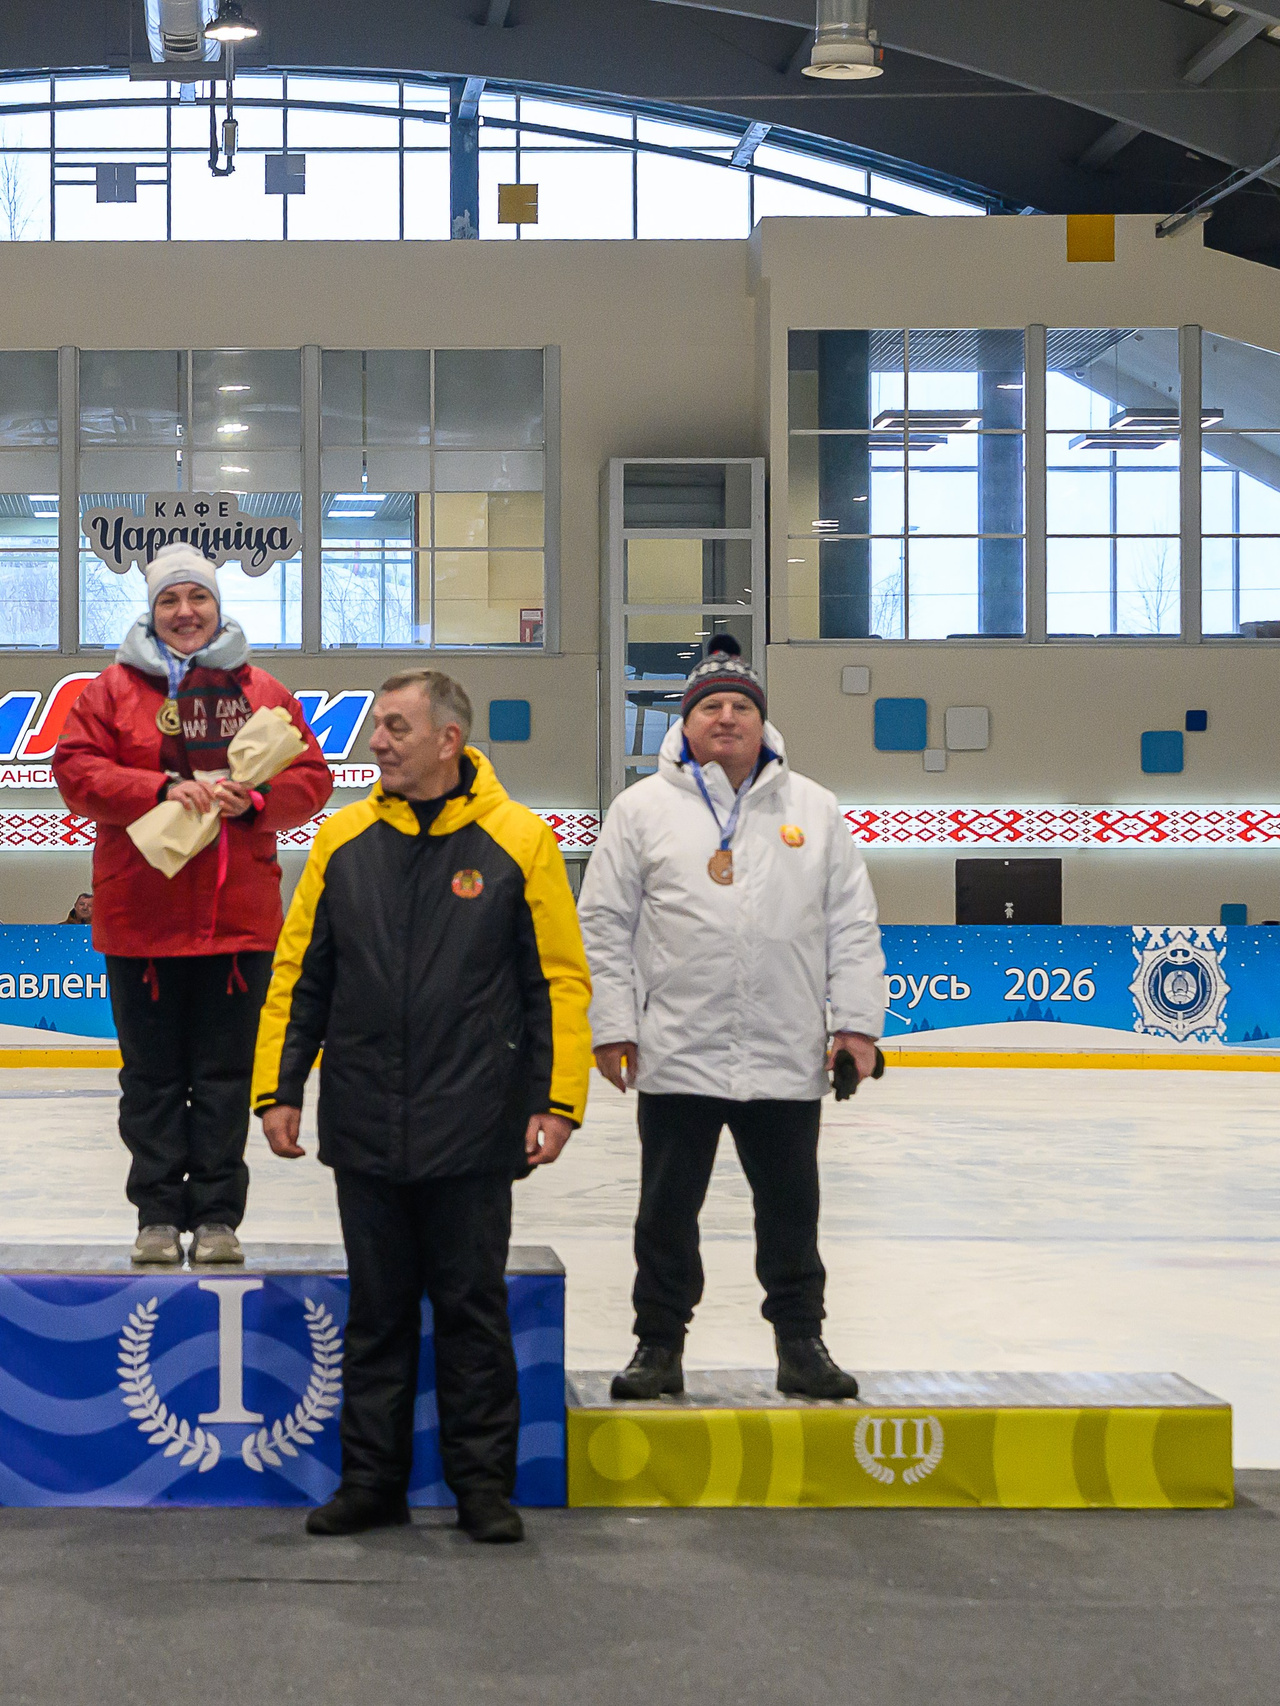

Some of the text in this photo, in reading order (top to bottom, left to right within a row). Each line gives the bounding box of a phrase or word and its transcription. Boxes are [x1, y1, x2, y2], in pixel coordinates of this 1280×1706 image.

[155, 502, 229, 517] КАФЕ
[1003, 967, 1096, 1001] 2026
[870, 1418, 930, 1458] III
